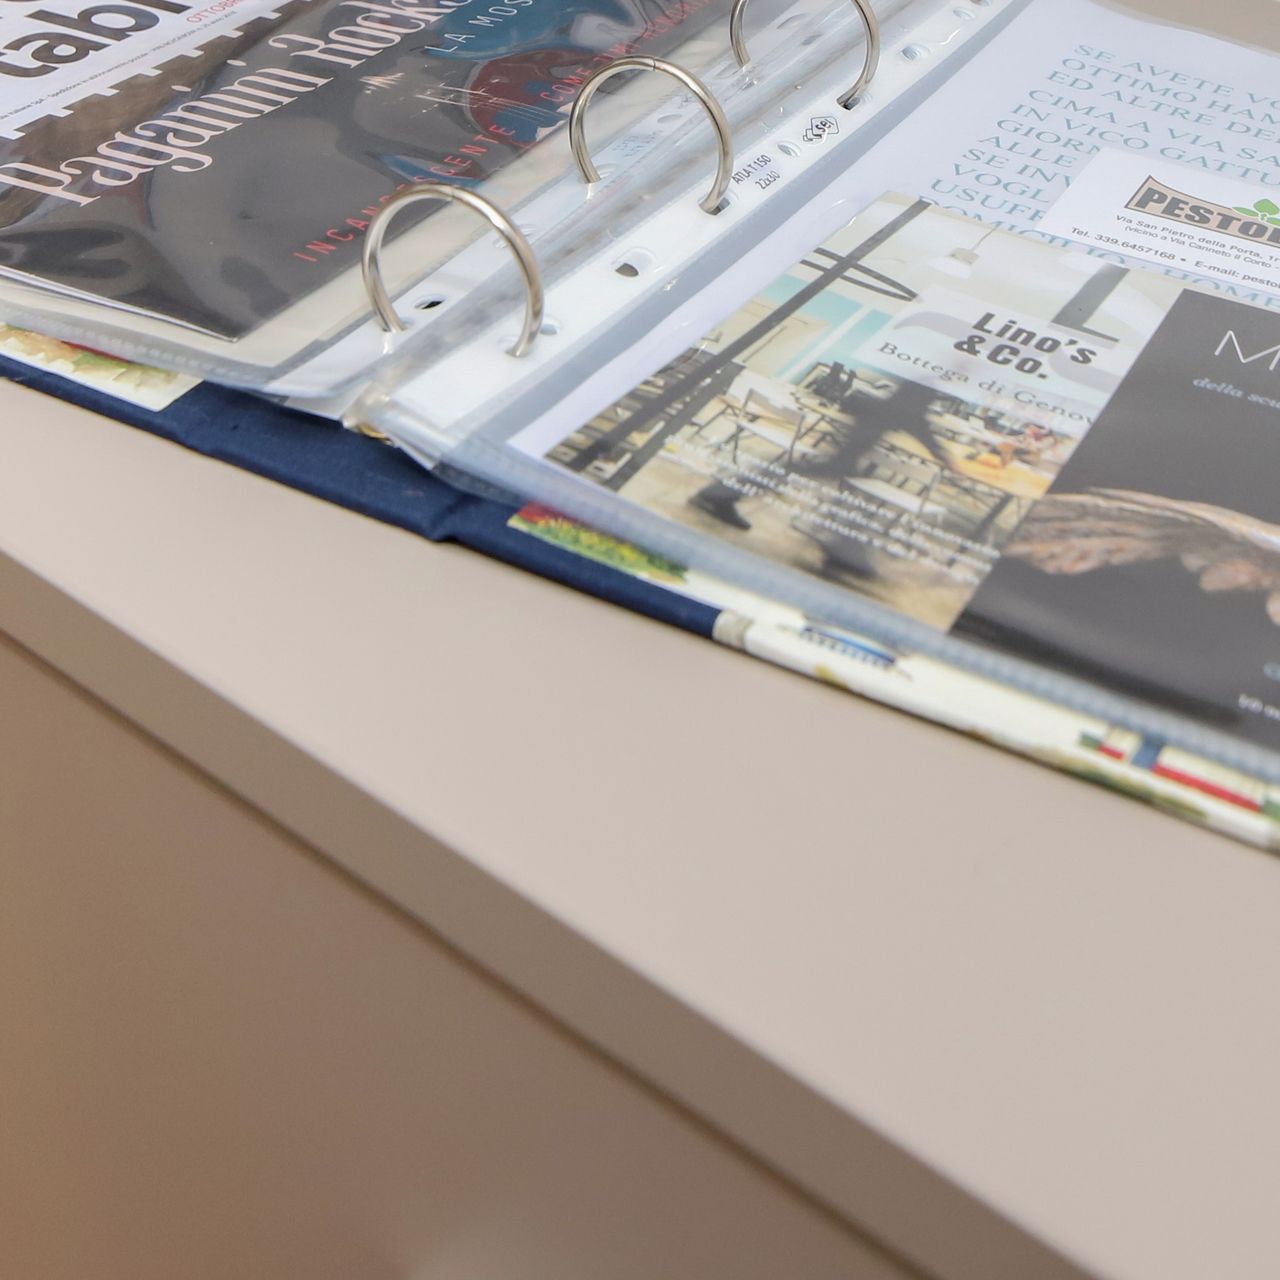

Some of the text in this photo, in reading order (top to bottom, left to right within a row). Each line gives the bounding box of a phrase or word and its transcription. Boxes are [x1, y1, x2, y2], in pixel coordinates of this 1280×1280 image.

[426, 30, 475, 54] LA
[1062, 57, 1198, 104] OTTIMO
[1073, 44, 1116, 63] SE
[1123, 62, 1234, 96] AVETE
[1046, 70, 1095, 91] ED
[1101, 90, 1221, 125] ALTRE
[996, 119, 1104, 155] GIORN
[1010, 104, 1051, 123] IN
[1064, 118, 1149, 150] VICO
[1028, 89, 1117, 124] CIMA
[1130, 121, 1152, 133] A
[1166, 128, 1225, 153] VIA
[962, 148, 1010, 169] SE
[979, 135, 1077, 168] ALLE
[953, 163, 1050, 204] VOGL
[1071, 226, 1090, 238] Tel.
[1094, 233, 1176, 261] 339.6457168
[1194, 260, 1240, 278] E-mail:
[1116, 215, 1133, 224] Via
[1136, 220, 1157, 231] San
[1160, 226, 1195, 240] Pietro
[1198, 236, 1227, 248] della
[1125, 225, 1158, 238] (vicino
[1170, 235, 1186, 246] Via
[1188, 241, 1231, 258] Canneto
[1243, 256, 1271, 268] Corto
[953, 334, 1050, 380] &Co.
[878, 341, 1094, 426] Bottega di Genov
[1192, 376, 1244, 399] della
